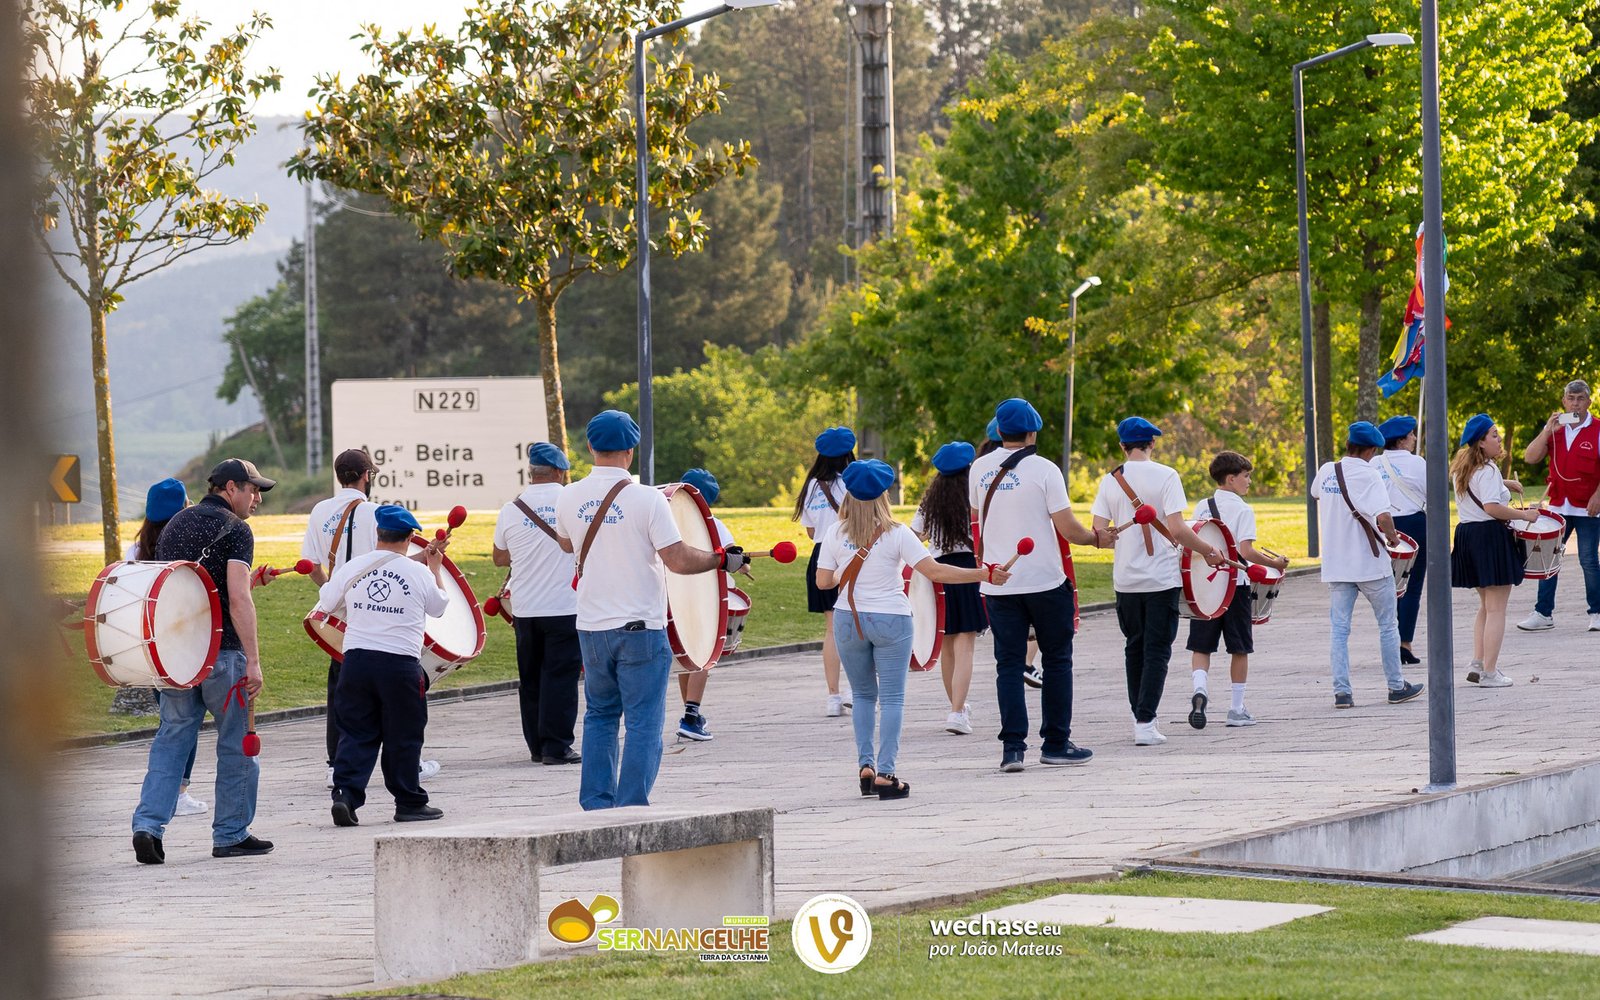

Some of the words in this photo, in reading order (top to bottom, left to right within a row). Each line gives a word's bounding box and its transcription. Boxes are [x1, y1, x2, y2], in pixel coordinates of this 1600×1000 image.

[418, 391, 476, 410] N229
[416, 444, 474, 462] Beira
[427, 469, 485, 487] Beira
[577, 500, 595, 519] GRUPO
[382, 569, 411, 596] BOMBOS
[353, 602, 363, 610] DE
[366, 603, 405, 615] PENDILHE
